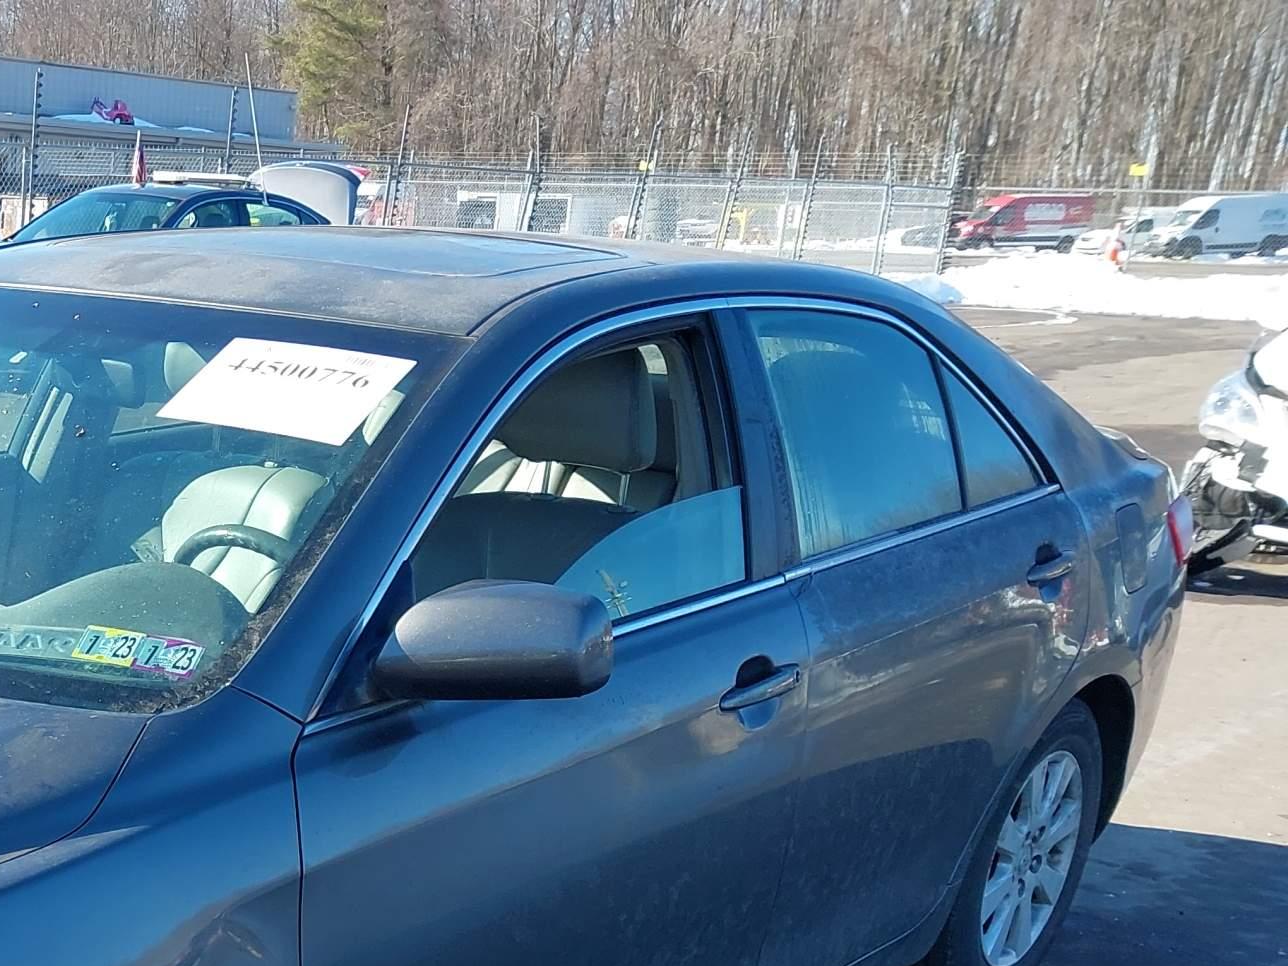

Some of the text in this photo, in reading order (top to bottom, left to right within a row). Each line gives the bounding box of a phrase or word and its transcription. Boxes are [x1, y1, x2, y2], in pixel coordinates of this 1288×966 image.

[228, 357, 369, 388] 44500776
[112, 636, 137, 659] 23
[172, 647, 196, 671] 23
